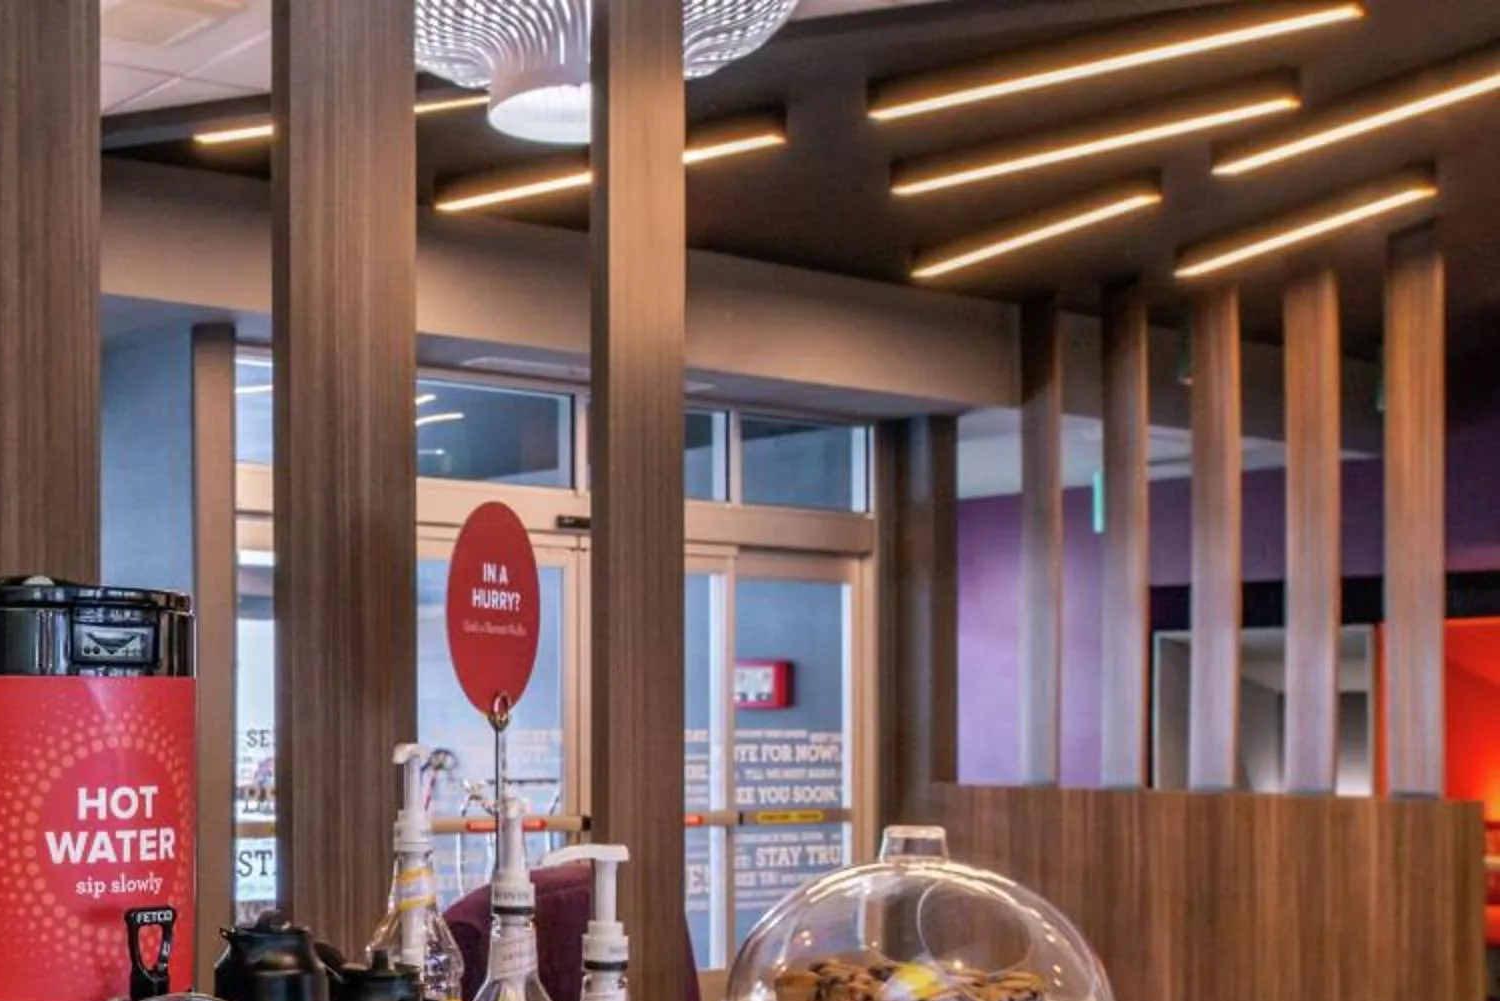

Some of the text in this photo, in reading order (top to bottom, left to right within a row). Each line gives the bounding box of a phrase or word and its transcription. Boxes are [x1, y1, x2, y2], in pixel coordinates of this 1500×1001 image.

[482, 562, 509, 586] IN A
[471, 587, 521, 612] HURRY?
[761, 744, 793, 762] FOR
[77, 785, 159, 821] HOT
[758, 786, 790, 804] YOU
[44, 827, 176, 865] WATER
[756, 847, 803, 867] STAY
[75, 871, 164, 899] sip slowly
[136, 909, 173, 924] FETCO
